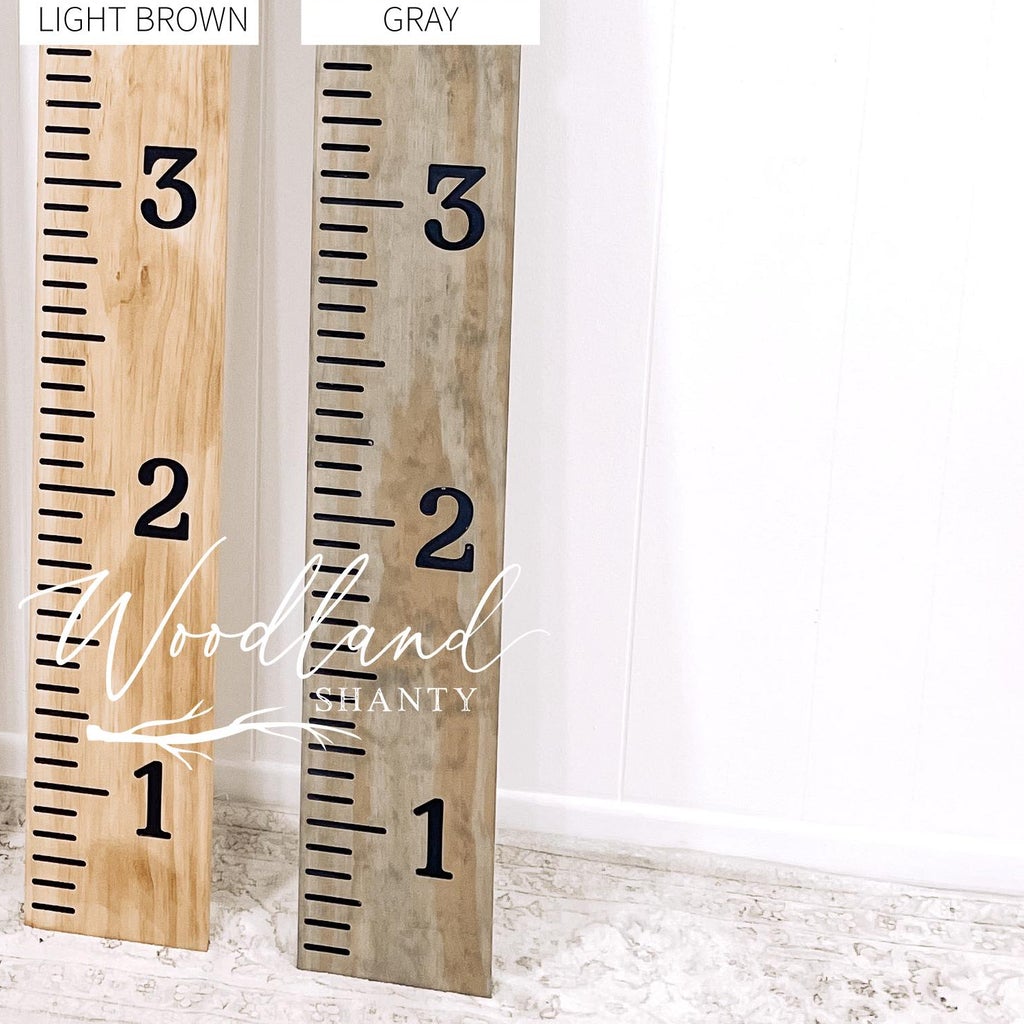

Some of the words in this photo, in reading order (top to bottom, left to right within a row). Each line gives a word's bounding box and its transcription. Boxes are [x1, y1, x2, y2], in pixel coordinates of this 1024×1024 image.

[141, 146, 197, 229] 3
[425, 164, 486, 250] 3
[135, 458, 189, 540] 2
[416, 487, 474, 572] 2
[134, 761, 171, 839] 1
[413, 798, 453, 879] 1
